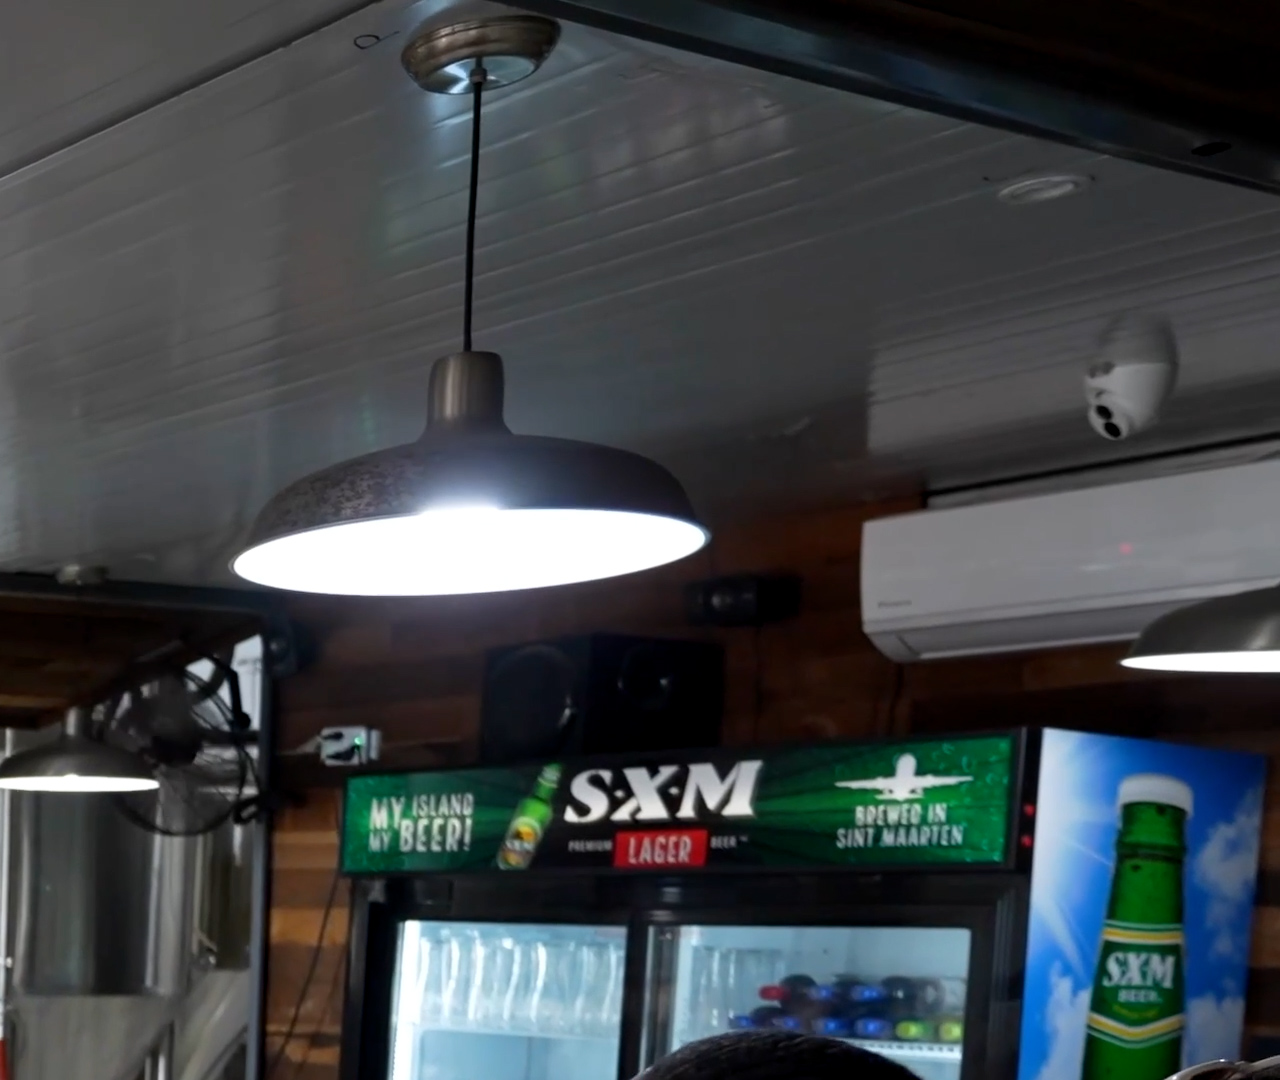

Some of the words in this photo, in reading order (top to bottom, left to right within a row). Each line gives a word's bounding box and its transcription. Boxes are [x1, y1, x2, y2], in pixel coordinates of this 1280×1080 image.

[369, 797, 406, 830] MY
[412, 793, 474, 818] ISLAND
[855, 803, 922, 827] BREWED
[927, 802, 948, 824] IN
[368, 831, 391, 852] MY
[399, 818, 474, 853] BEER!
[568, 838, 614, 852] PREMIUM
[628, 835, 692, 865] LAGER
[836, 826, 875, 849] SINT
[880, 825, 964, 848] MAARTEN
[1102, 951, 1176, 989] SXM
